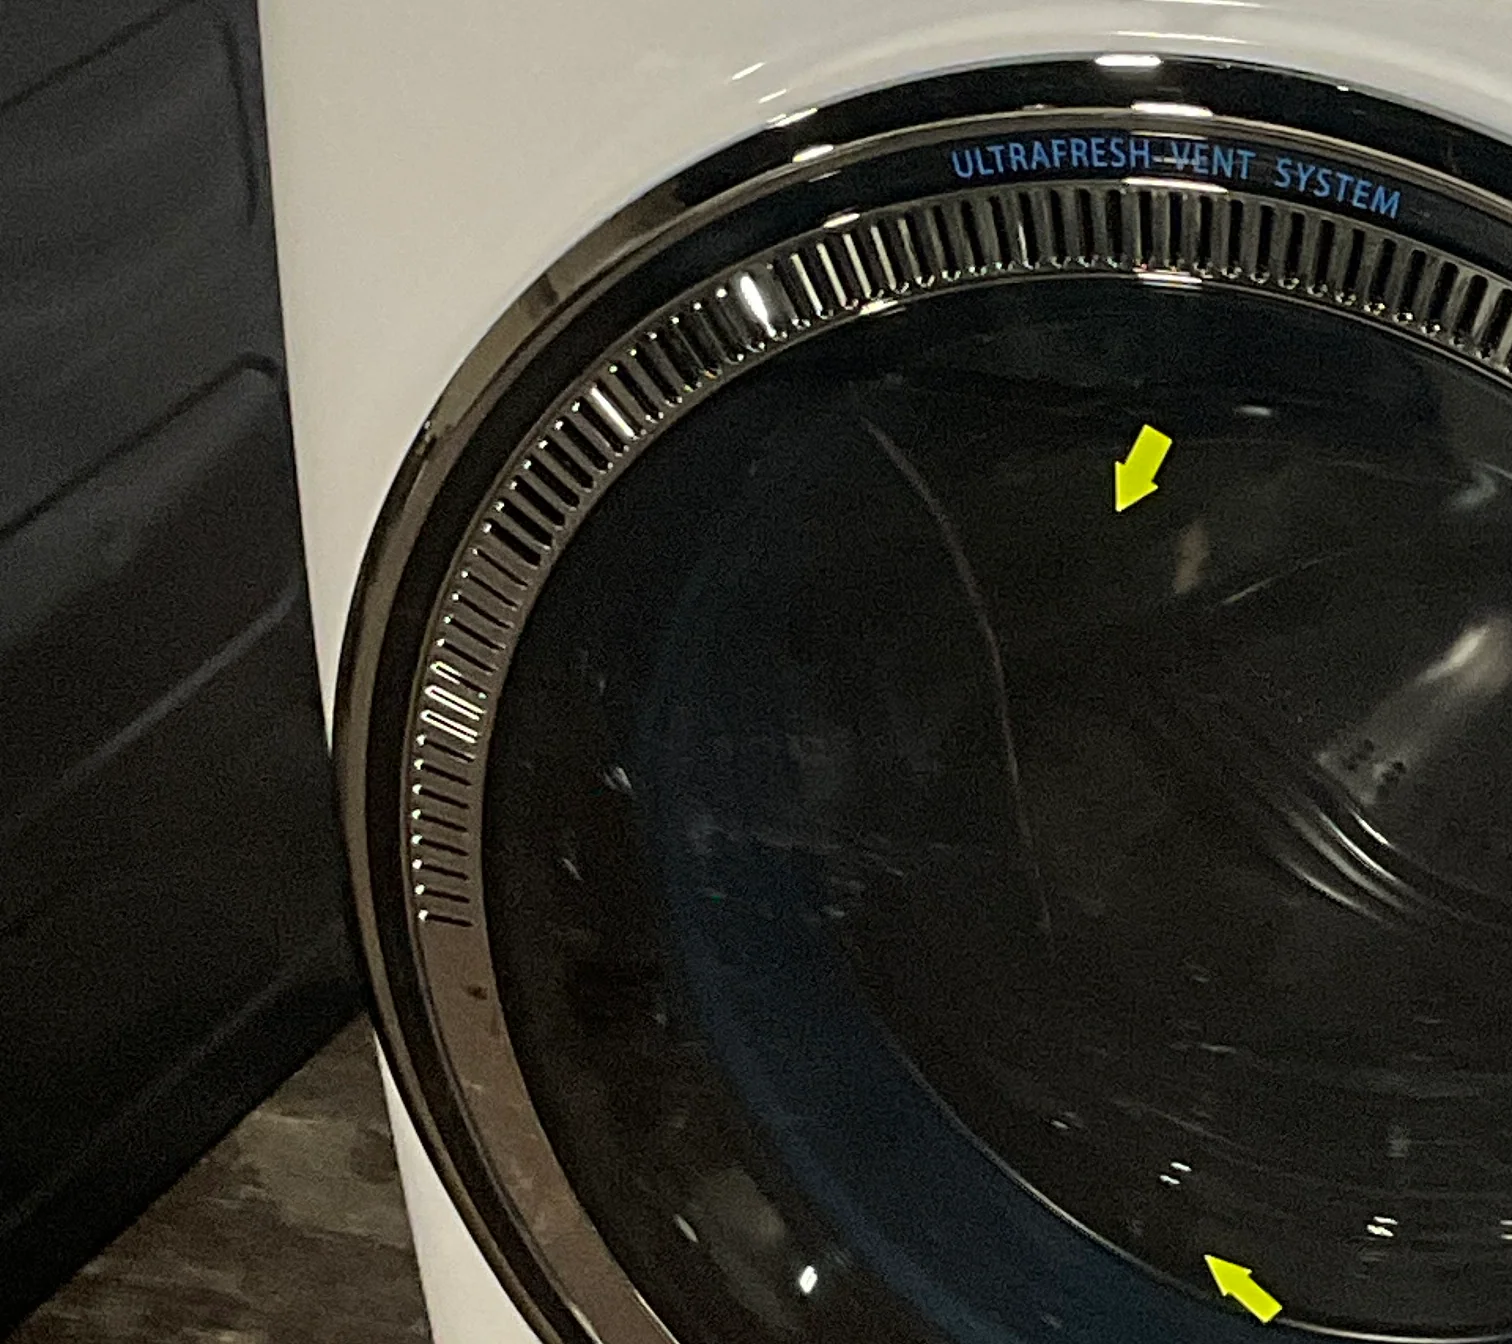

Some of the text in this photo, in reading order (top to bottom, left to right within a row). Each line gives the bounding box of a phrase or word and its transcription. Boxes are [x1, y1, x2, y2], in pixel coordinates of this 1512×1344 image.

[951, 136, 1401, 220] ULTRAFRESH VENT SYSTEM
